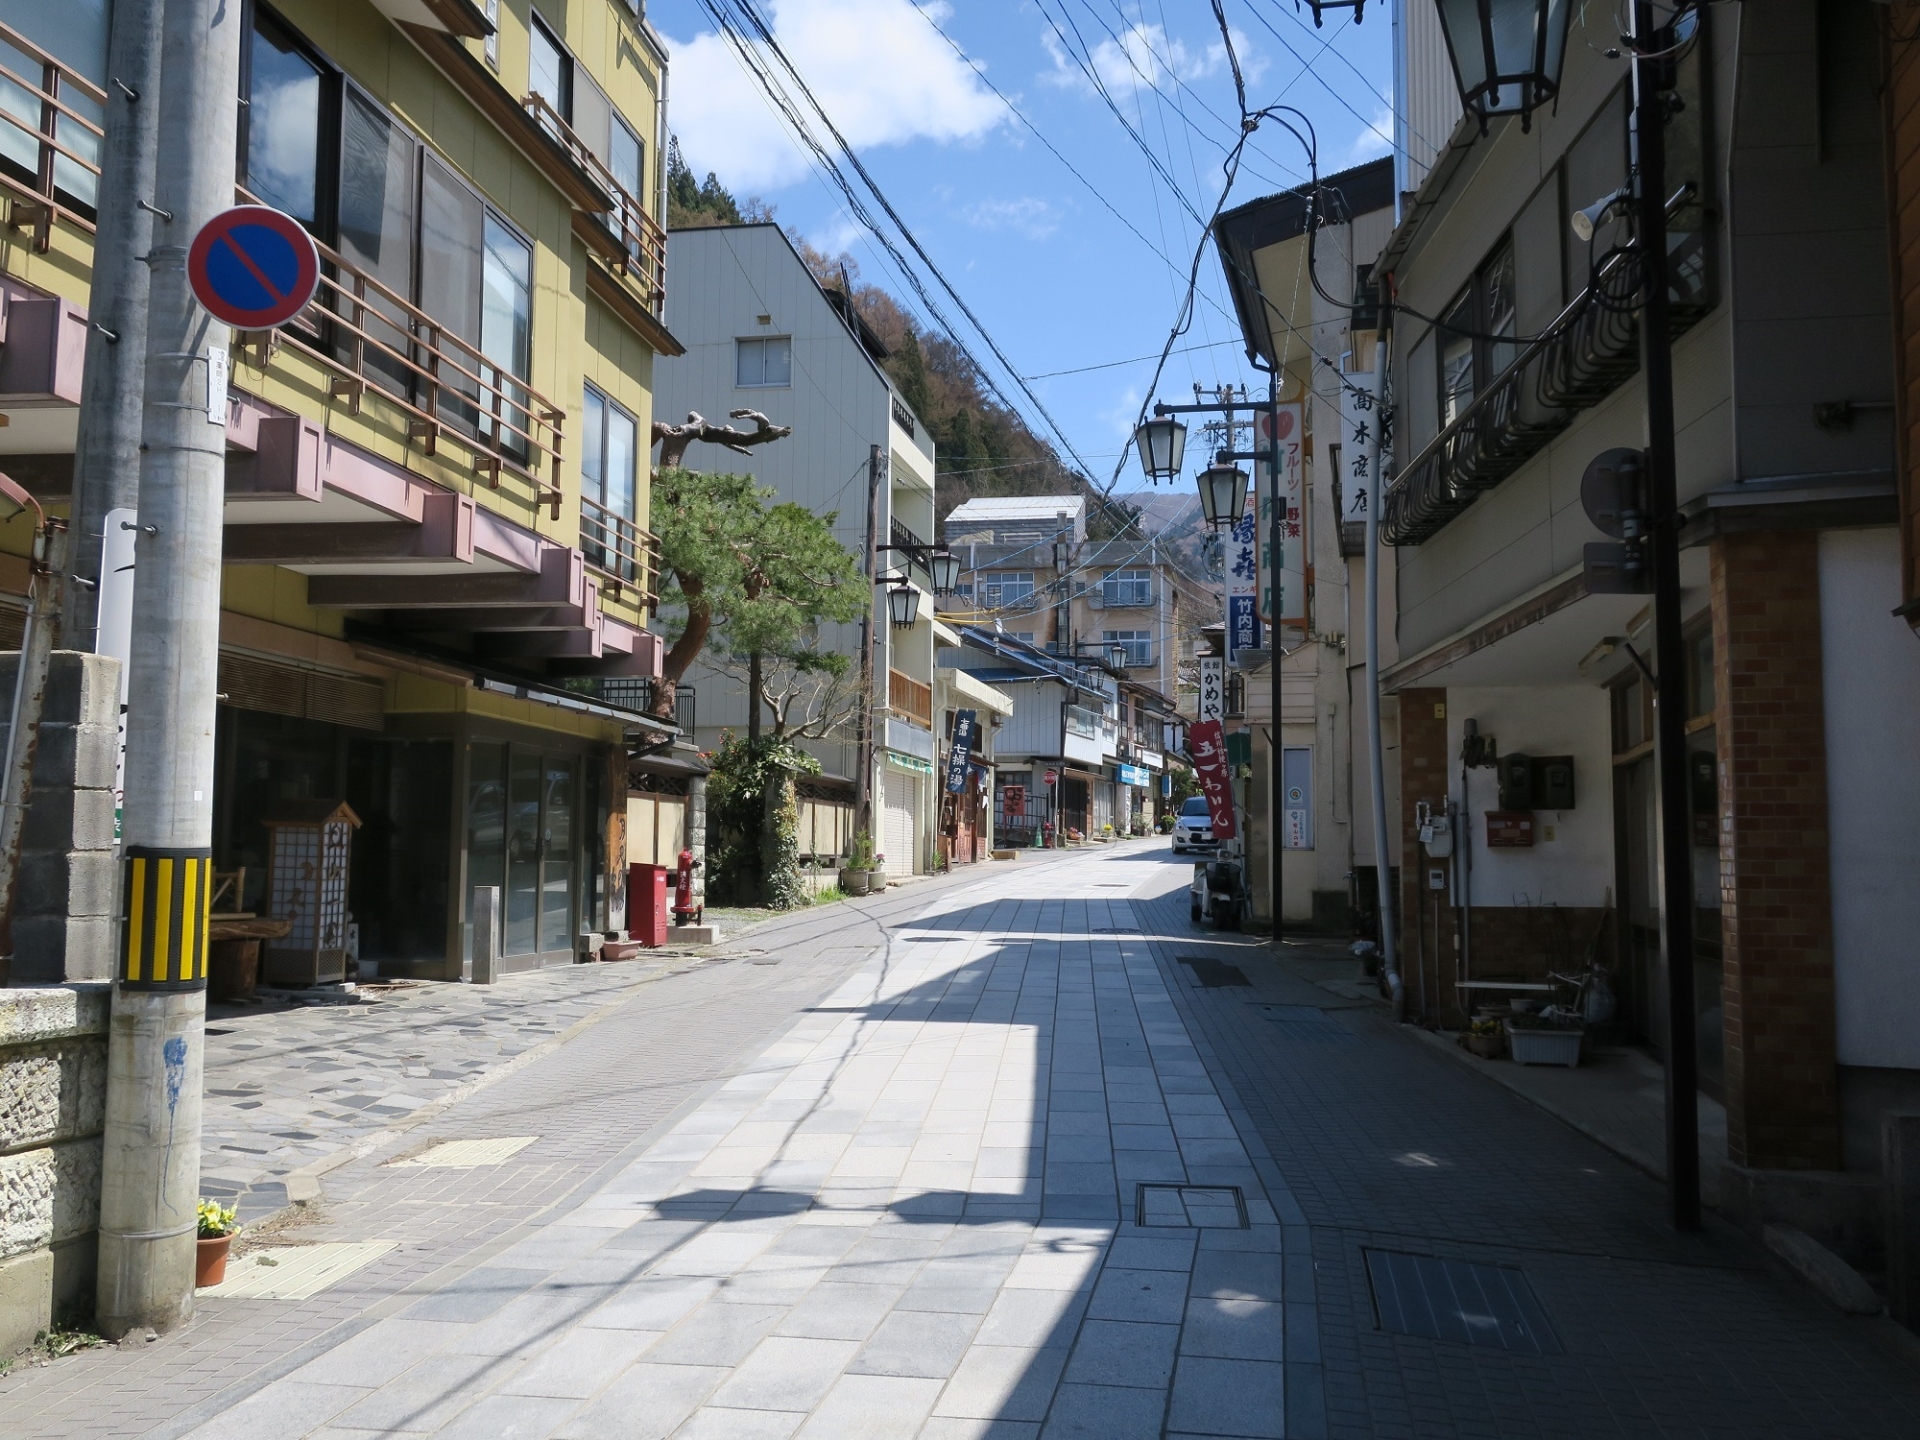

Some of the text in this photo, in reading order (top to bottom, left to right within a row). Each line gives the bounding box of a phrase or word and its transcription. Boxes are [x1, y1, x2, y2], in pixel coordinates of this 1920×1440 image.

[1286, 442, 1301, 538] フルーツ・野菜
[1237, 598, 1254, 649] 竹内商
[1204, 673, 1220, 721] かめや
[1194, 740, 1229, 827] 五一わいん
